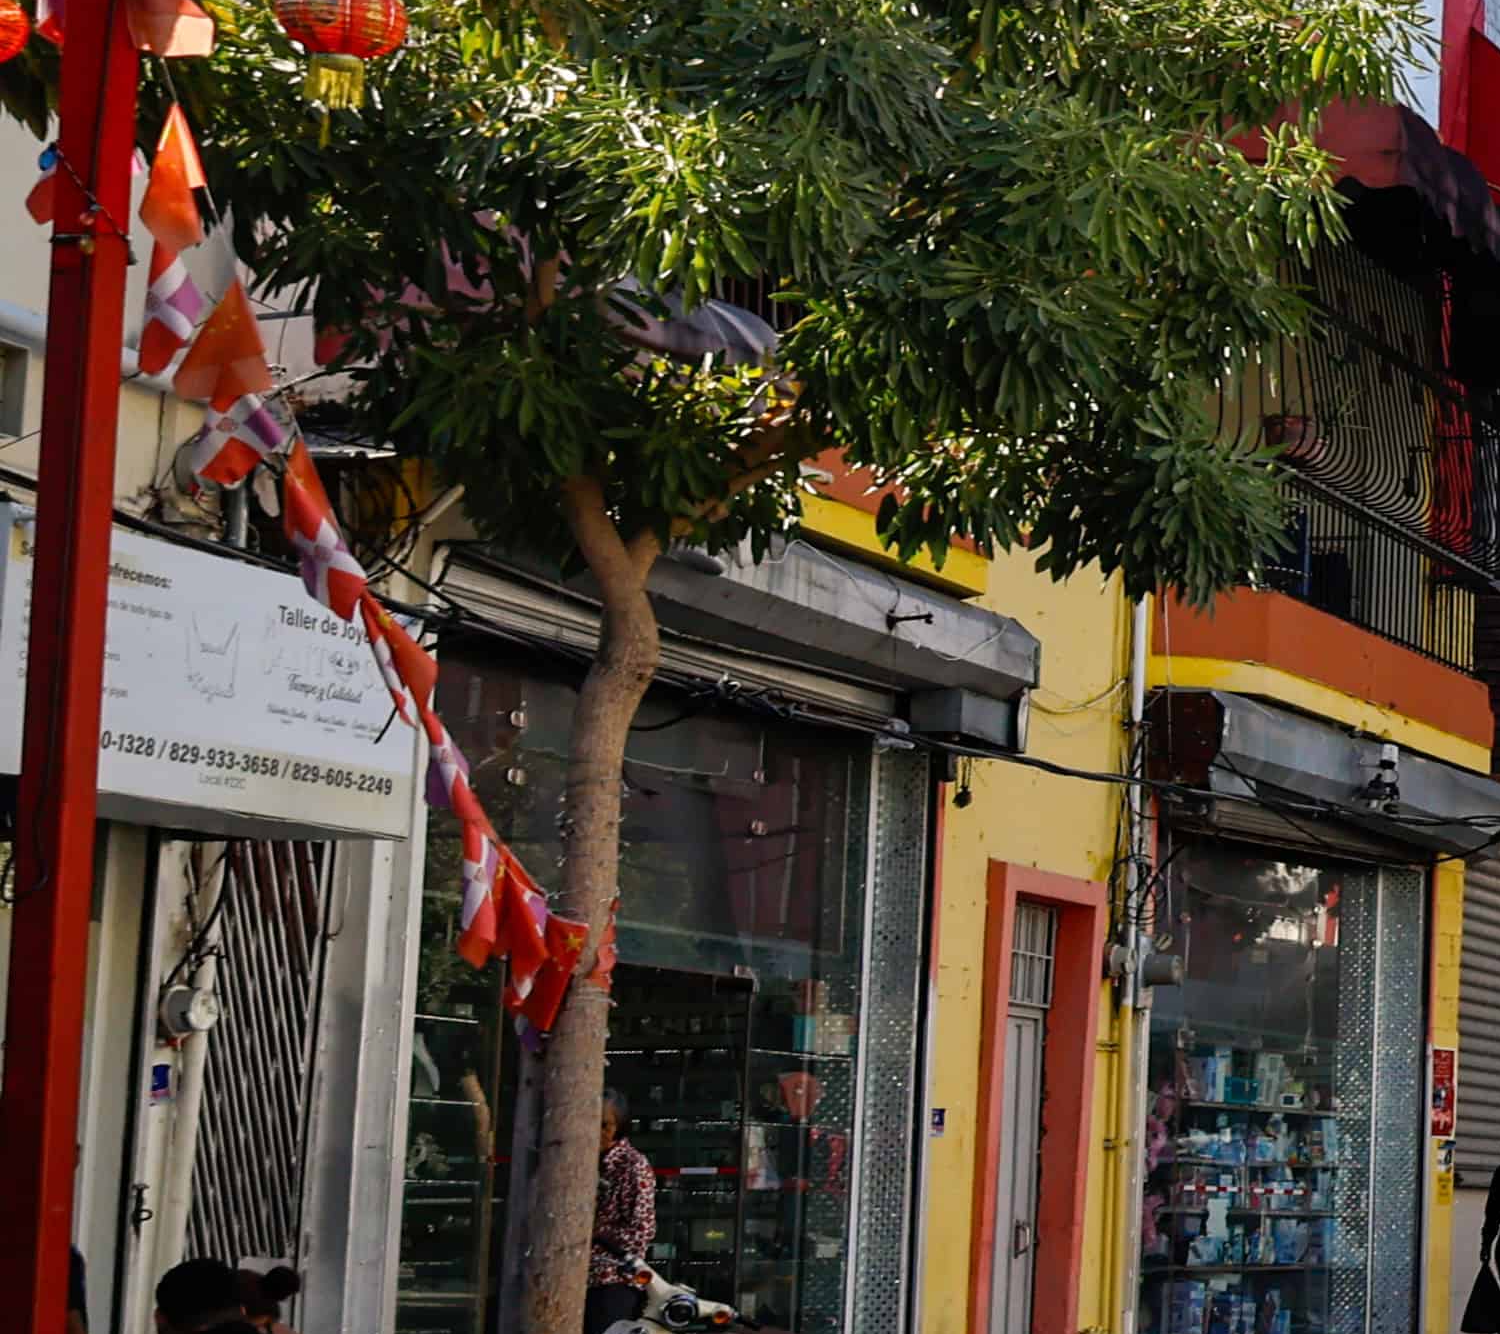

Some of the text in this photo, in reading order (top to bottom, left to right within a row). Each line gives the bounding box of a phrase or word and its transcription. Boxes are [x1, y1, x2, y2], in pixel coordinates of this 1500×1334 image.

[278, 605, 318, 631] Taller
[321, 615, 339, 636] de
[169, 742, 280, 778] 829-933-3658
[291, 764, 393, 796] 829-605-2249
